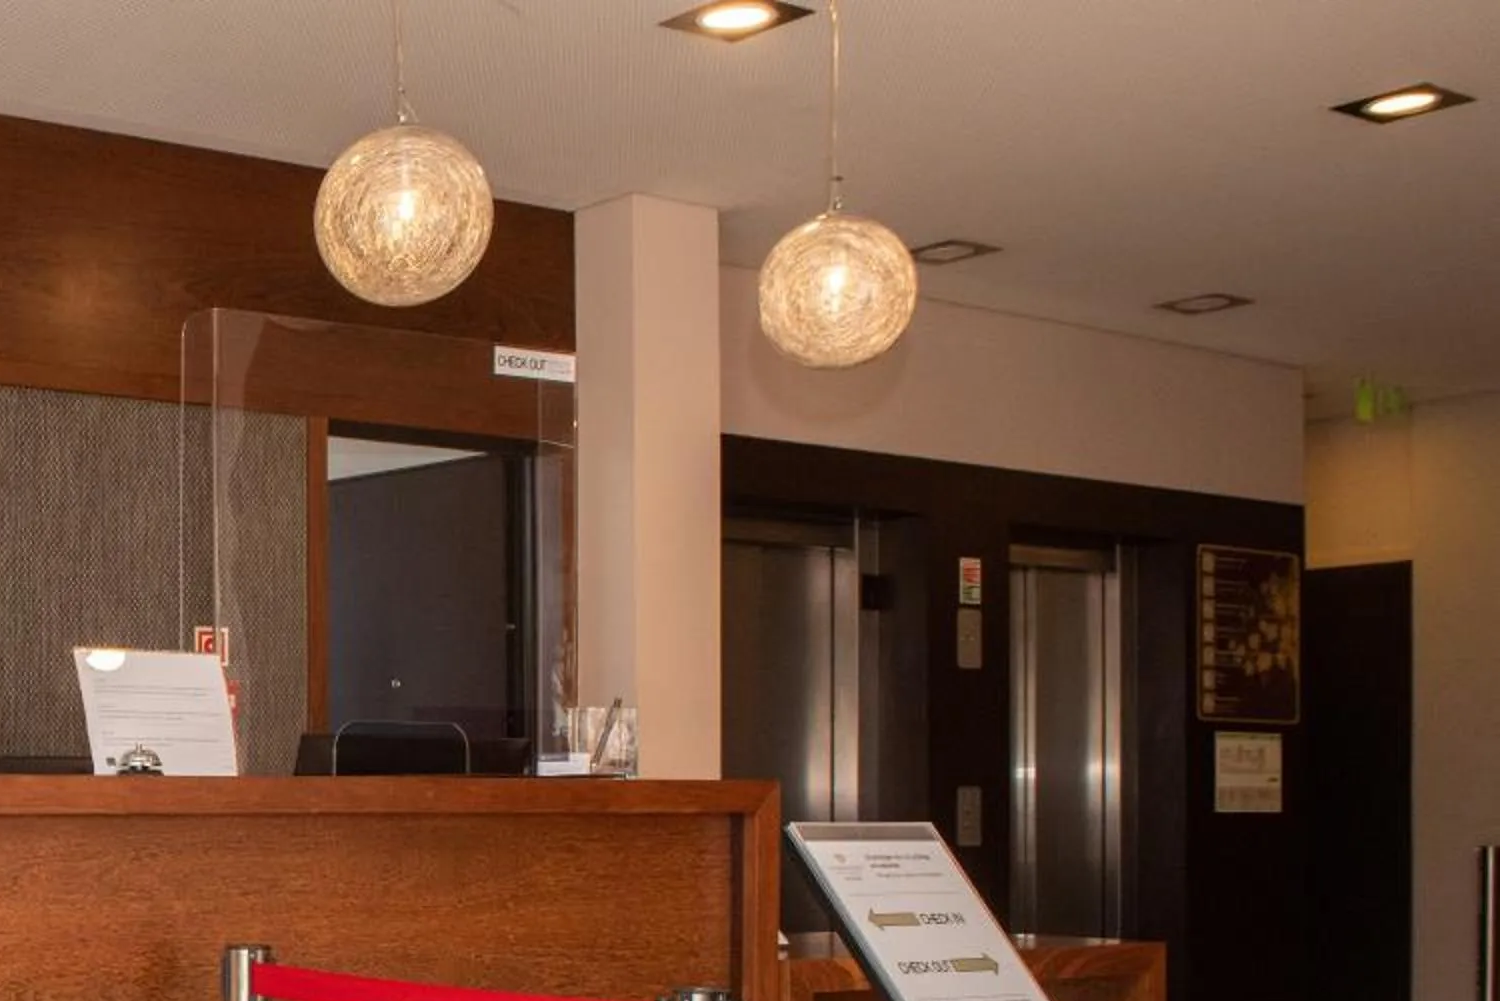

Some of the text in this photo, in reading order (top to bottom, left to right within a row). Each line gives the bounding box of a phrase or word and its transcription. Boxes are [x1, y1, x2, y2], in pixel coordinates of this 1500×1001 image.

[498, 354, 528, 369] CHECK
[529, 358, 547, 371] OUT
[919, 911, 965, 925] CHECK IN
[897, 959, 959, 975] CHECK OUT
